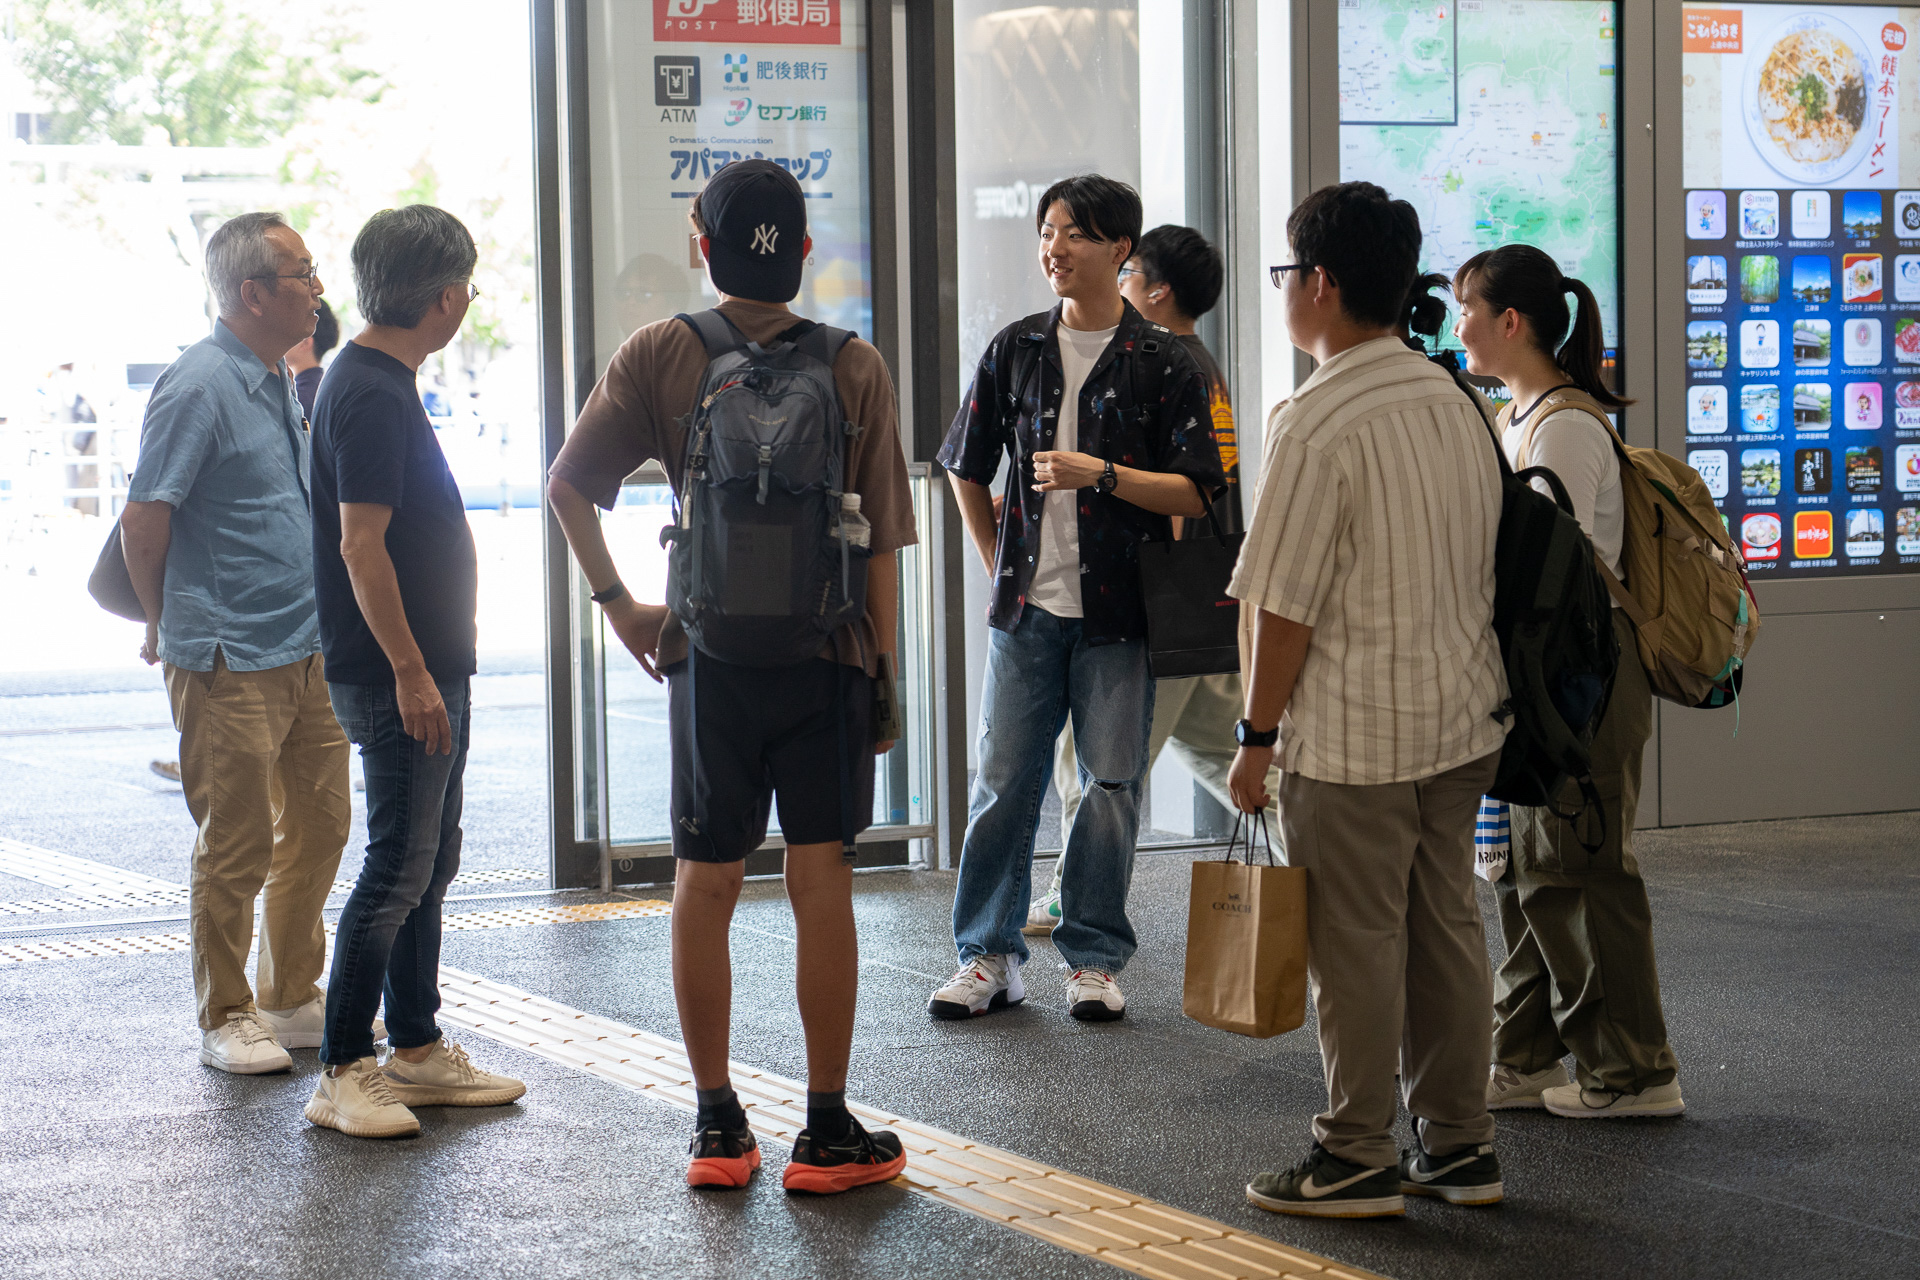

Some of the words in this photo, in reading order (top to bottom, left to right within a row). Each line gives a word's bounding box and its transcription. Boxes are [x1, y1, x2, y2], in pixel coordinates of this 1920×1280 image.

[736, 0, 831, 27] 郵便局
[665, 20, 717, 30] POST
[1882, 29, 1905, 46] 元祖
[756, 61, 828, 81] 肥後銀行
[660, 109, 697, 123] ATM
[757, 104, 827, 122] セブン銀行
[1869, 54, 1897, 178] 熊本ラーメン
[669, 136, 707, 145] Dramatic
[710, 136, 774, 145] Communication
[1212, 901, 1252, 914] COACH
